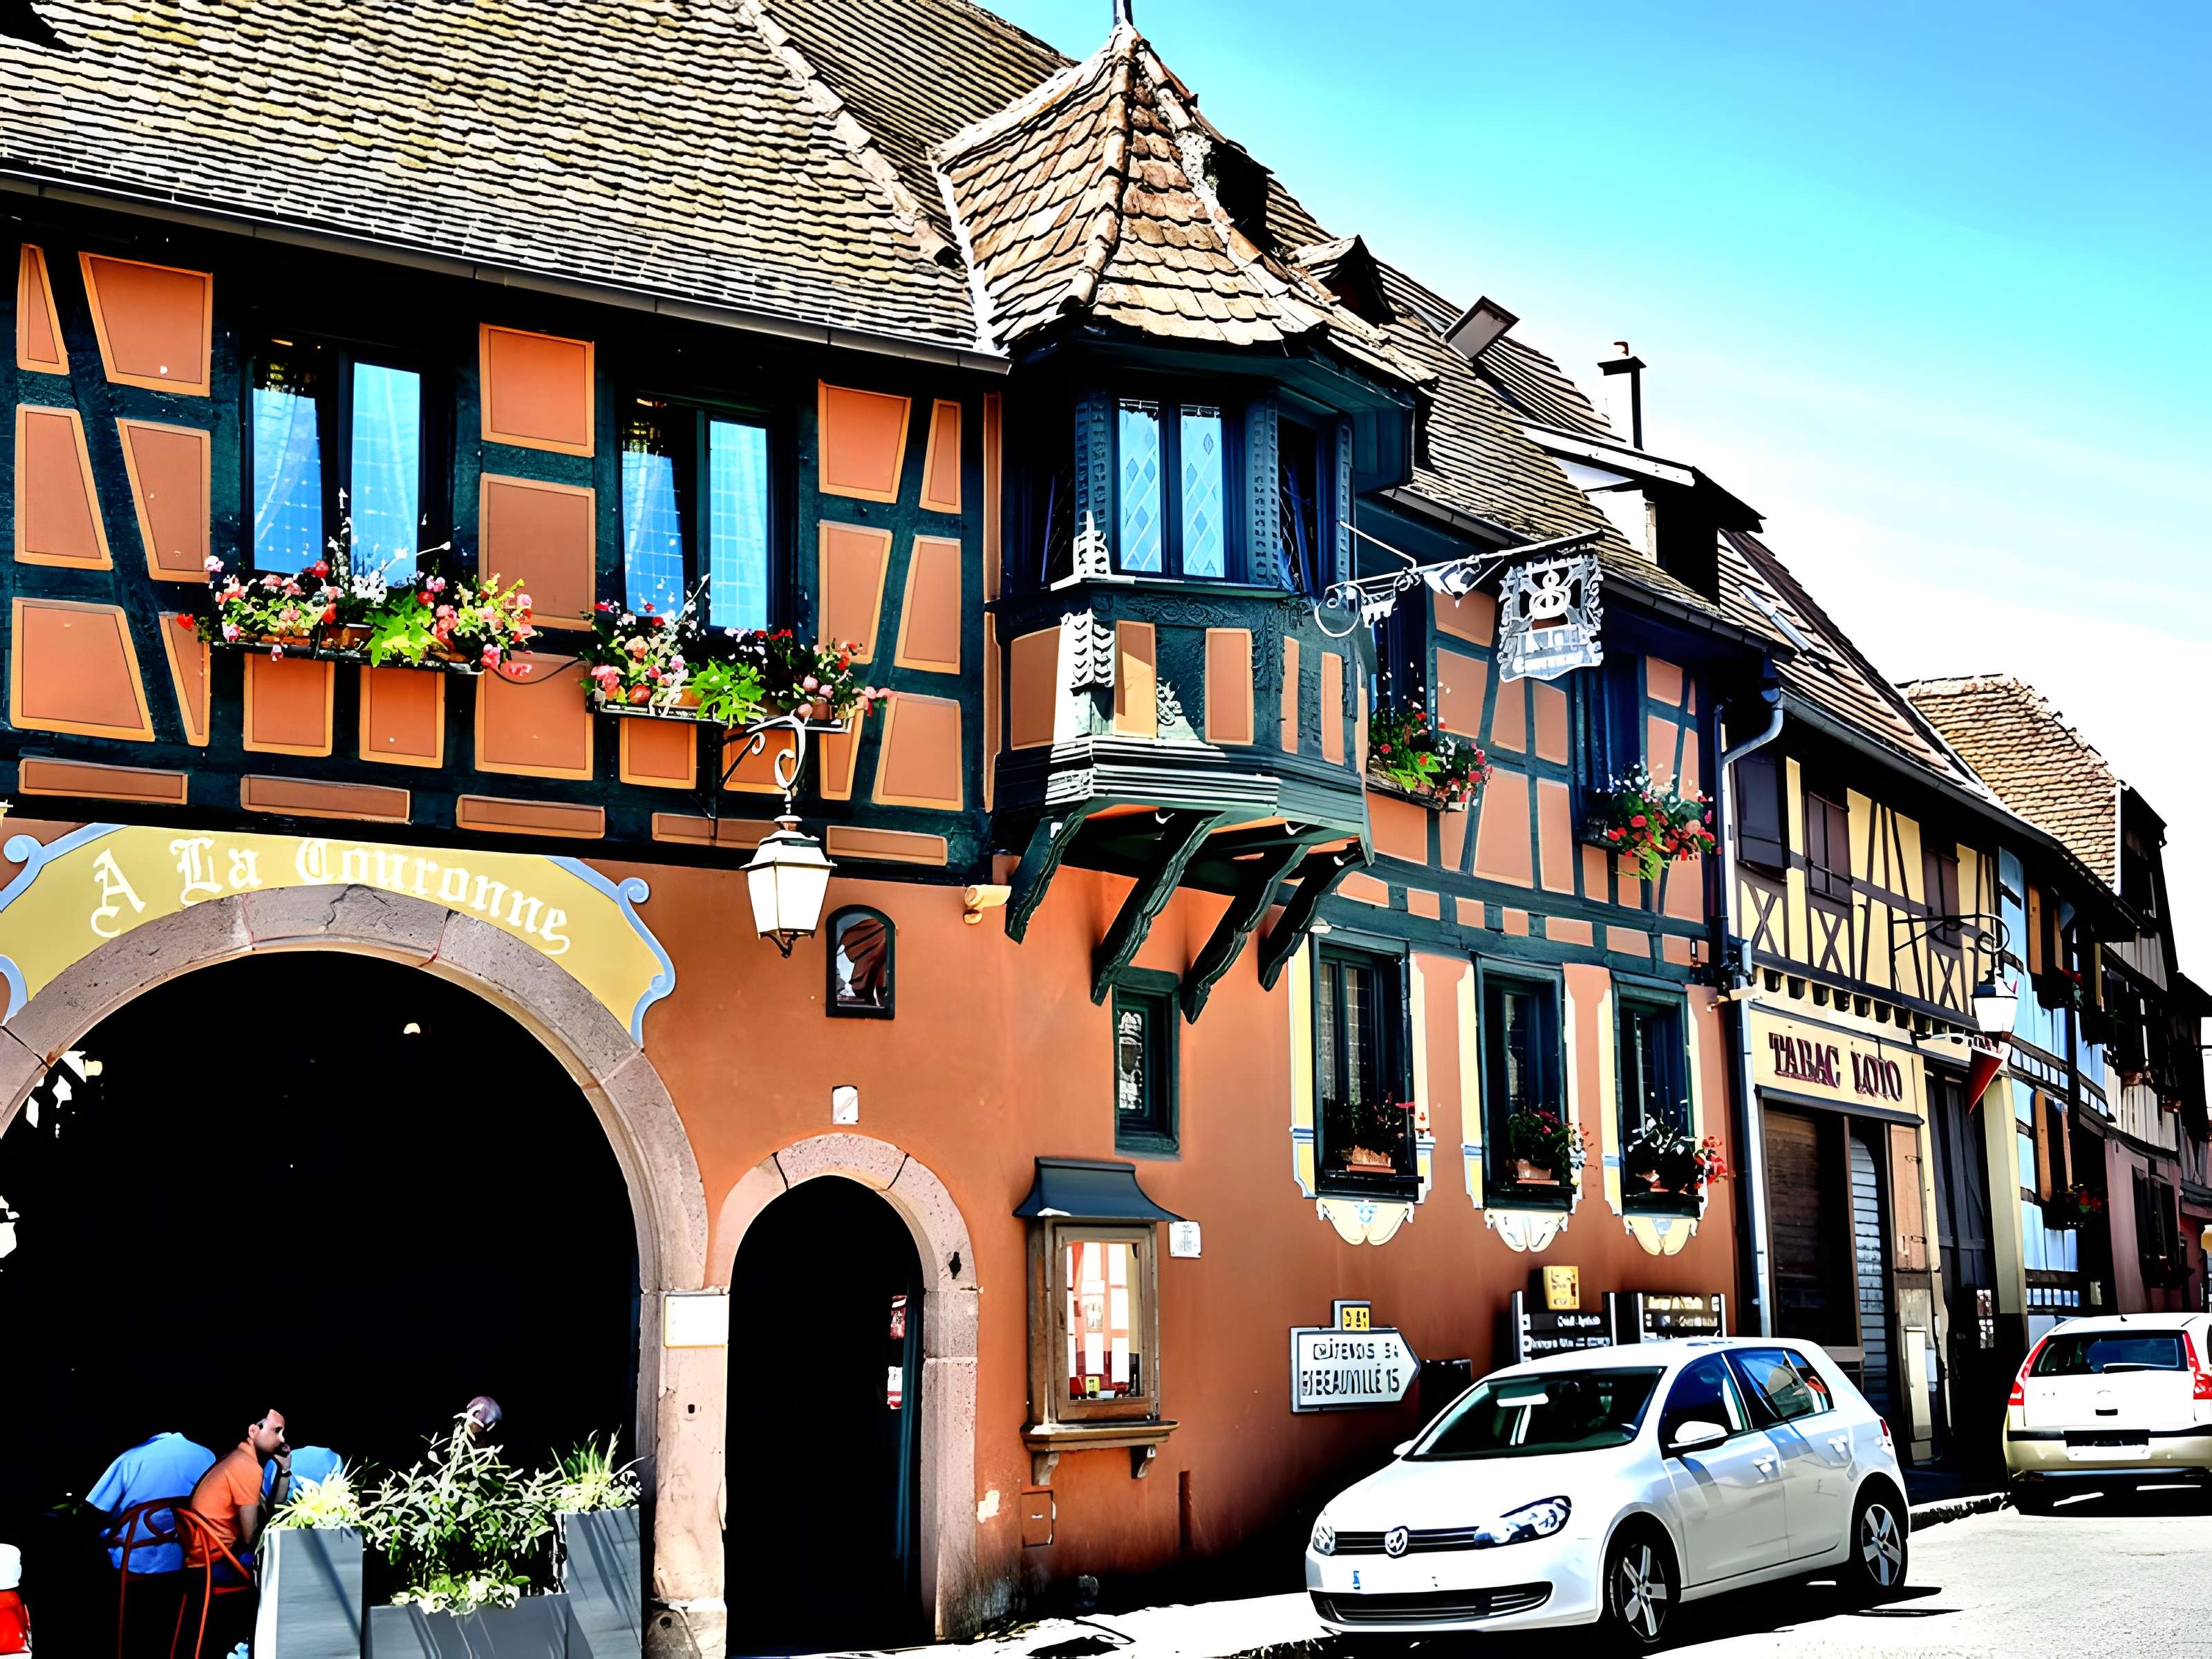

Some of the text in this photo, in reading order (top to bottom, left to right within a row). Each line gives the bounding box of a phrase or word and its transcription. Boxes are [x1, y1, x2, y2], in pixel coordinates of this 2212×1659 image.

[91, 837, 572, 955] A La Couronne
